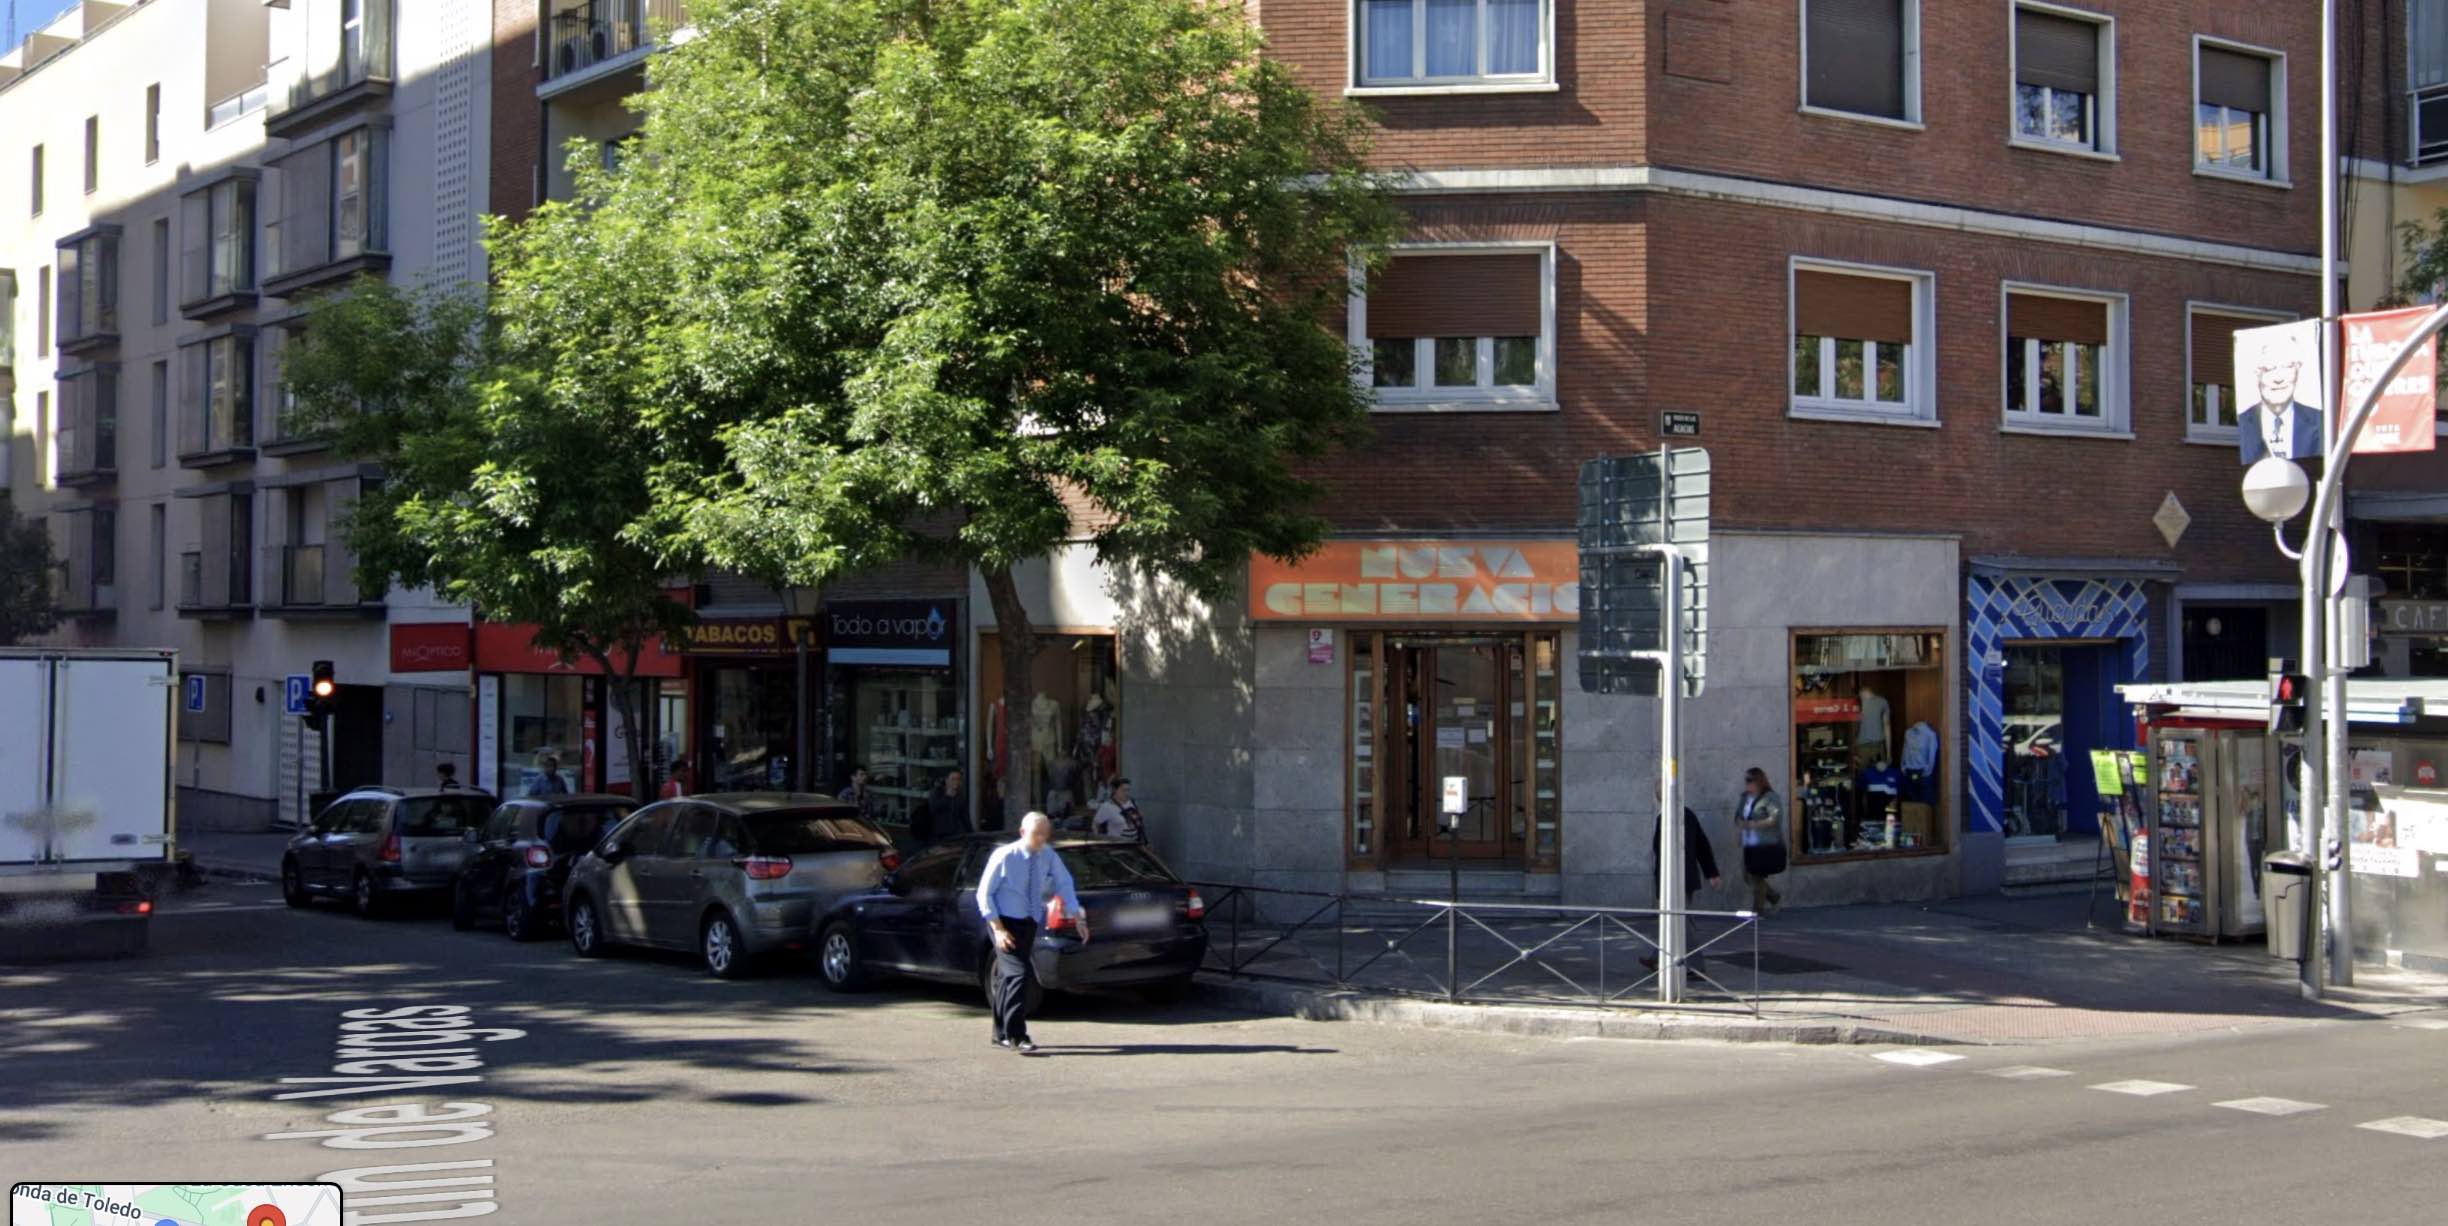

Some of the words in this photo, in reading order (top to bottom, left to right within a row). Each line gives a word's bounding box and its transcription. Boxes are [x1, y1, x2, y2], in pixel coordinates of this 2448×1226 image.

[1361, 546, 1535, 579] NUEVA
[831, 614, 873, 636] Todo
[876, 618, 890, 636] a
[892, 615, 945, 641] vapor
[2395, 606, 2448, 630] CAF
[683, 625, 777, 643] TABACOS
[290, 679, 302, 709] P
